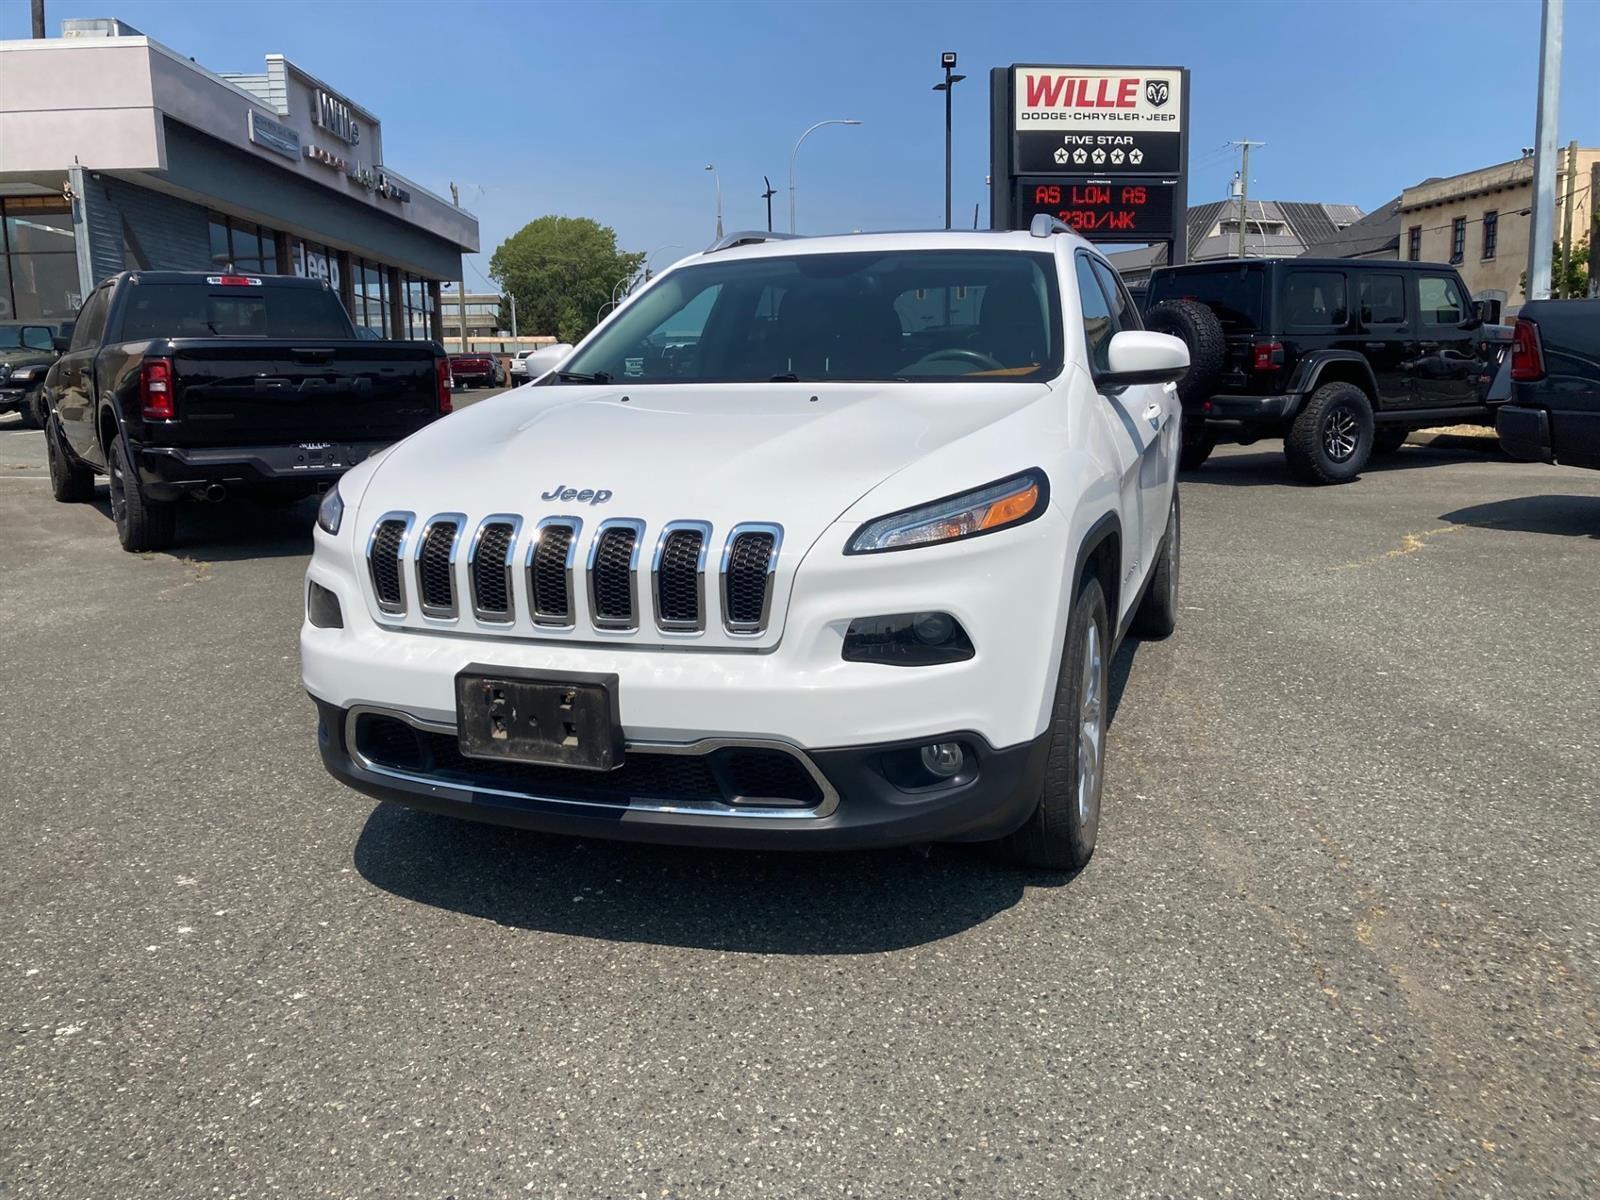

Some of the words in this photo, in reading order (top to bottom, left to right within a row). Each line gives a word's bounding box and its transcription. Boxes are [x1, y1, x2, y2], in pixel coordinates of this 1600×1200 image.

[1026, 75, 1140, 108] WILLE
[311, 89, 360, 146] Wille
[1022, 112, 1067, 120] DODGE
[1073, 112, 1141, 121] CHRYSLER
[1146, 113, 1176, 122] JEEP
[1064, 135, 1094, 145] FIVE
[1097, 135, 1133, 145] STAR
[1035, 186, 1061, 204] AS
[1072, 186, 1110, 205] LOW
[1121, 187, 1147, 205] AS
[541, 484, 613, 506] Jeep
